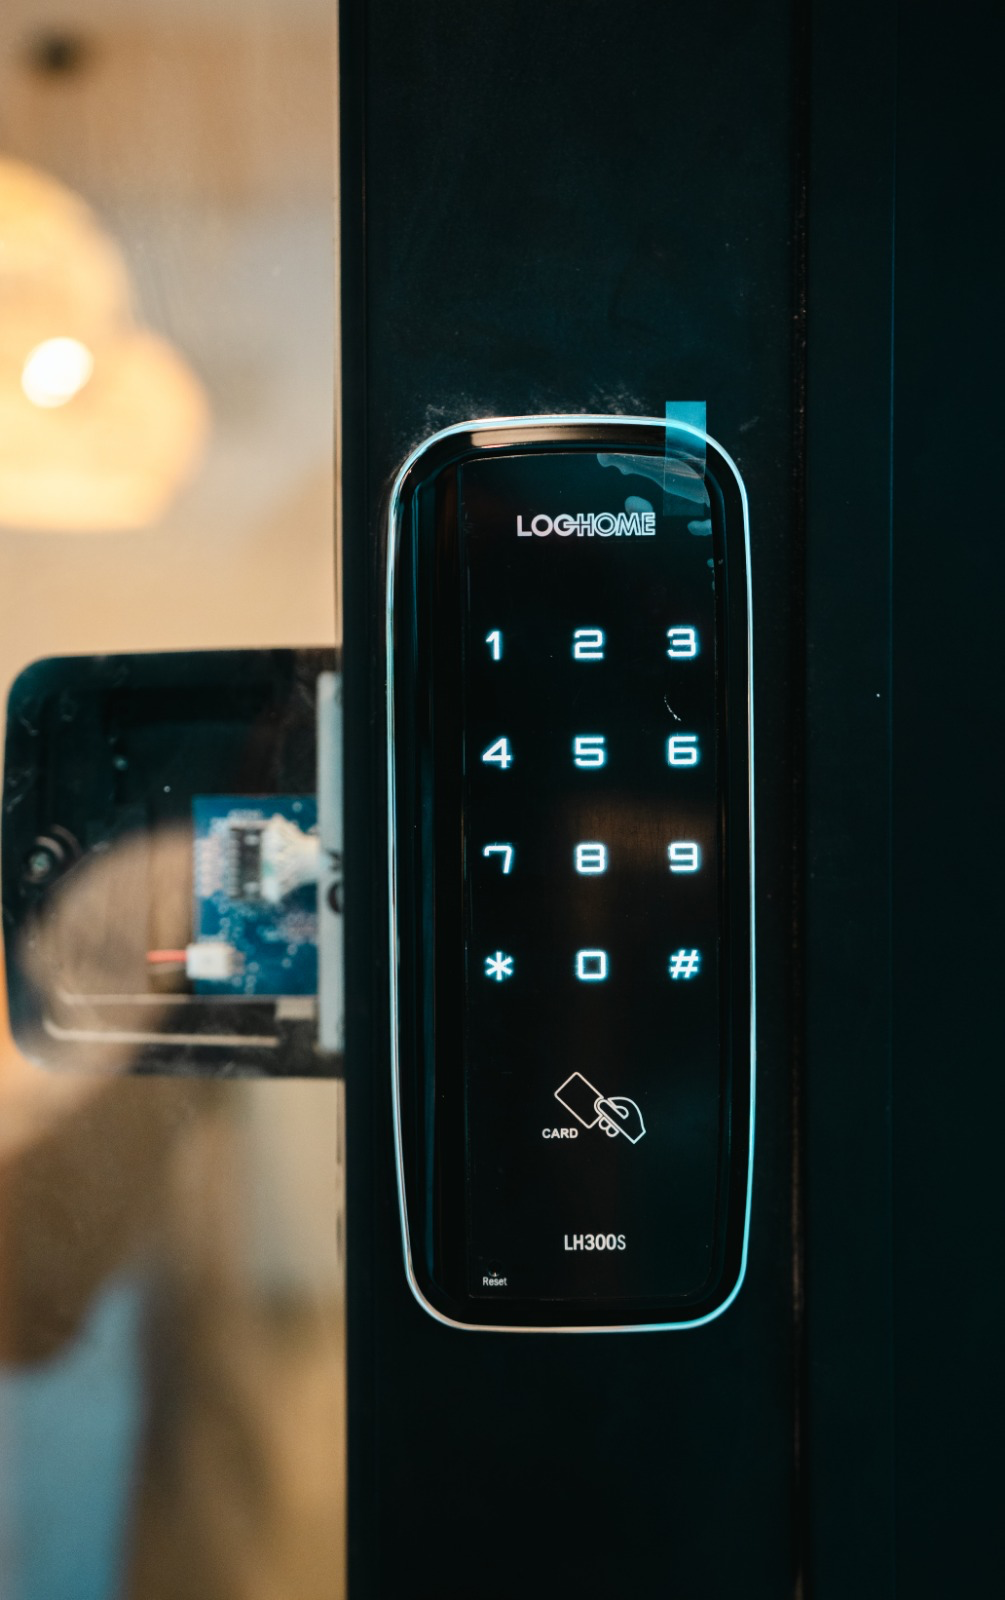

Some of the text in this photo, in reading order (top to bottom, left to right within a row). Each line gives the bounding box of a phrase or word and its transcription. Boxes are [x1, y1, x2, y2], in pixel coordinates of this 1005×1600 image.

[516, 511, 656, 537] LOGHOME
[485, 626, 700, 661] 1 2 3
[482, 733, 700, 770] 4 5 6
[482, 840, 702, 875] 7 8 9
[575, 948, 608, 982] 0
[668, 948, 702, 980] #
[541, 1128, 579, 1139] CARD
[564, 1234, 626, 1251] LH300S
[482, 1276, 508, 1287] Reset
